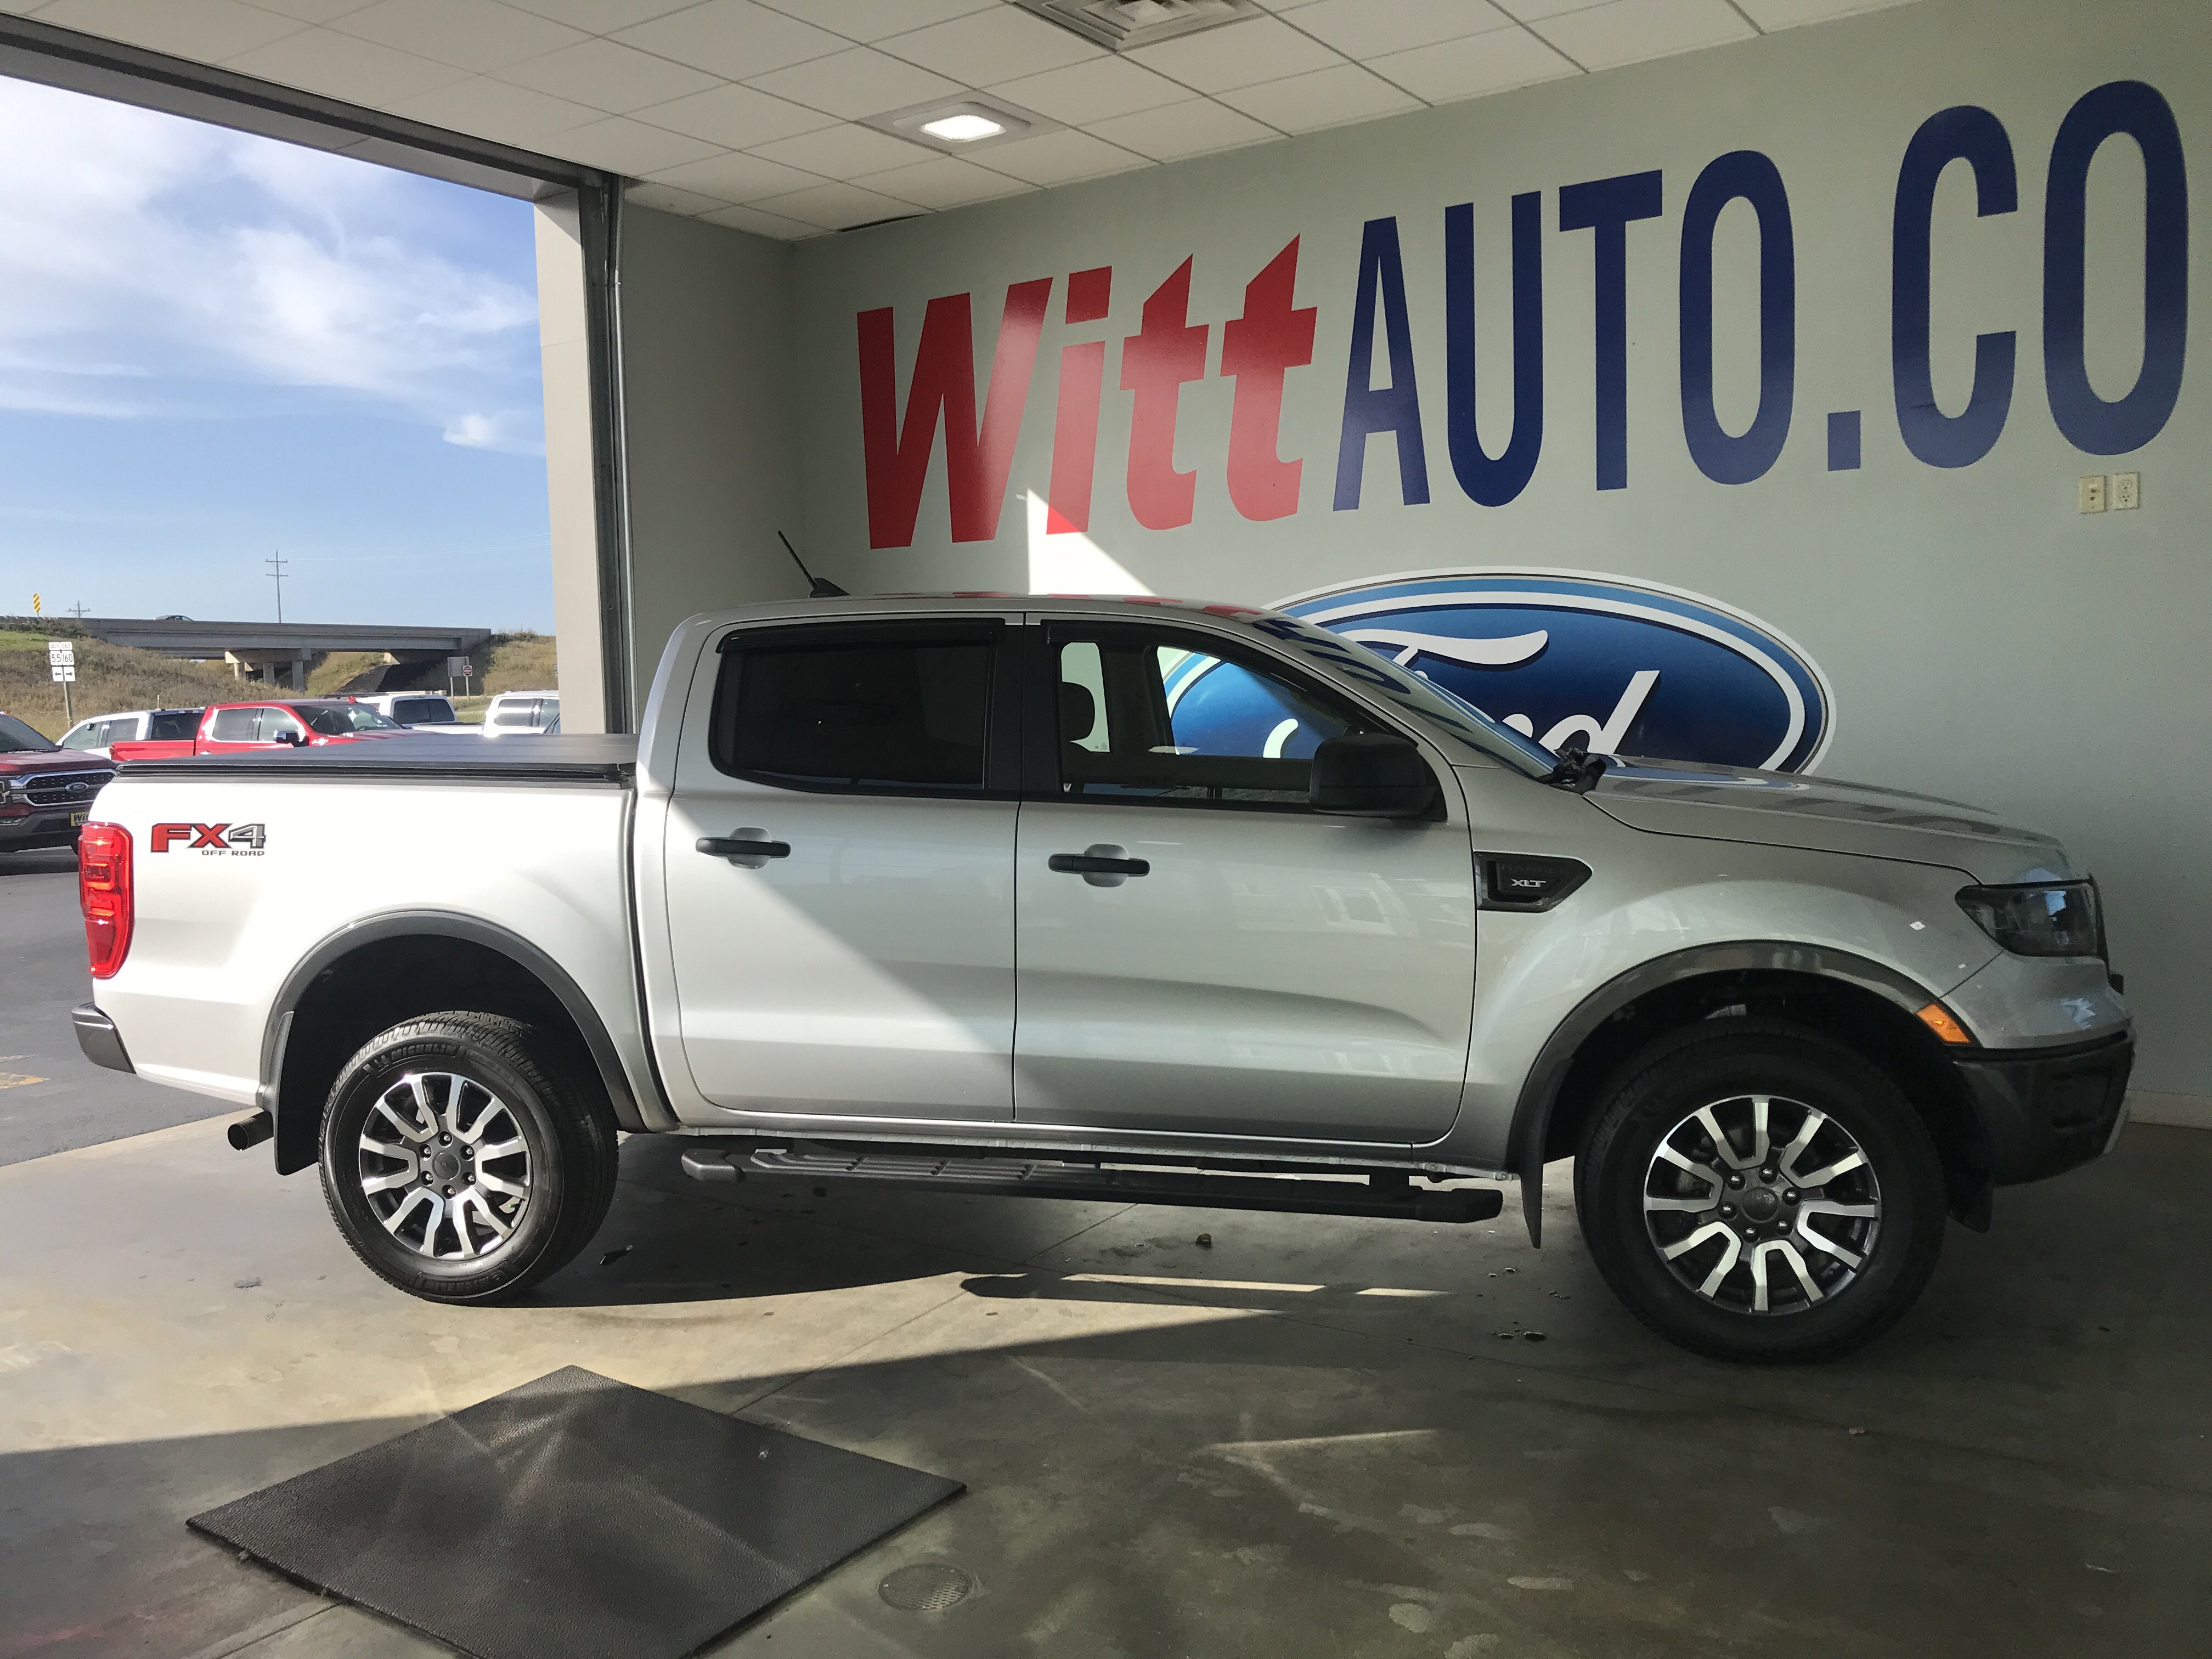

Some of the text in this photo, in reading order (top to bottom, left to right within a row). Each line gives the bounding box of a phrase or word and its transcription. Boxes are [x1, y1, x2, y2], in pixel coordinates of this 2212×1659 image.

[52, 653, 61, 663] 55
[62, 653, 73, 663] 160
[150, 823, 266, 853] FX4
[1510, 878, 1547, 888] XLT
[391, 1043, 460, 1060] MICHELIN
